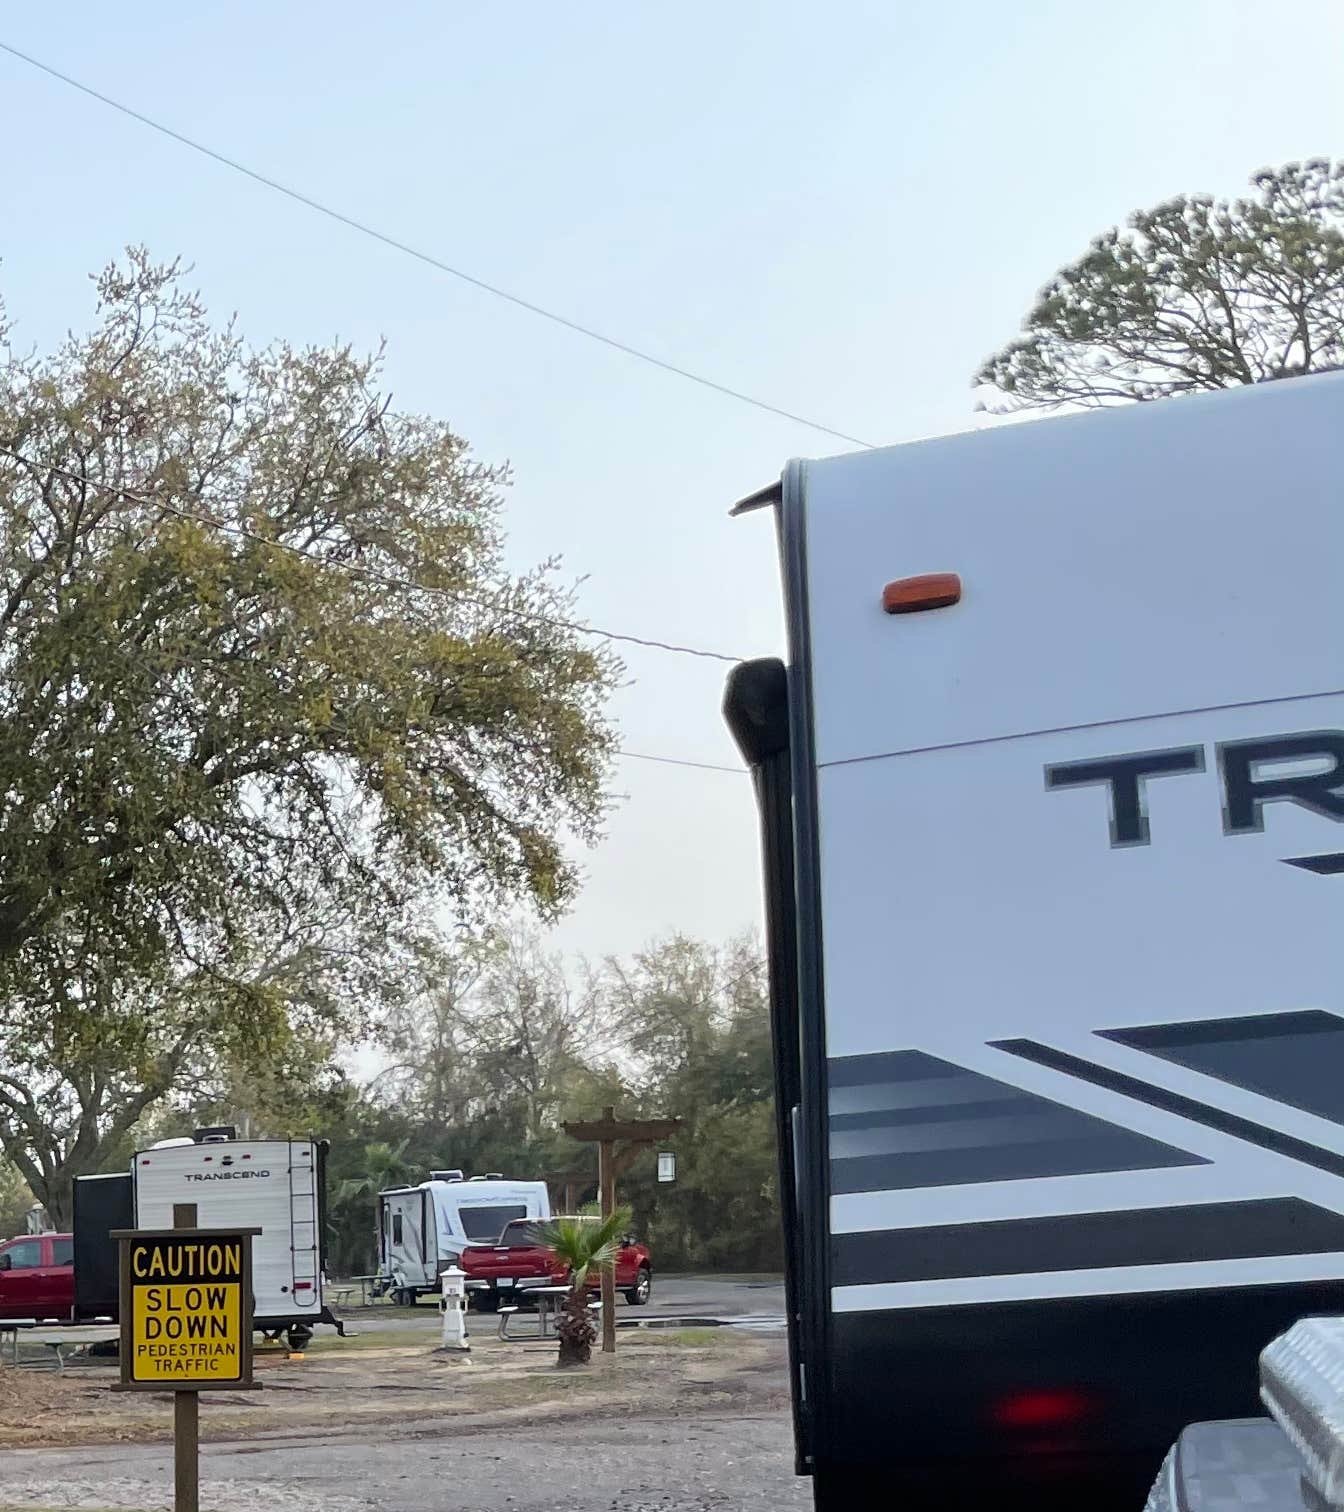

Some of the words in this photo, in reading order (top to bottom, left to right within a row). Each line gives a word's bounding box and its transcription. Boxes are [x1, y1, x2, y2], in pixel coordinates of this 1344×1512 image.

[184, 1170, 270, 1181] TRANSCEND
[132, 1244, 241, 1278] CAUTION
[146, 1287, 227, 1312] SLOW
[145, 1315, 228, 1340] DOWN
[137, 1343, 236, 1357] PEDESTRIAN
[154, 1358, 219, 1372] TRAFFIC
